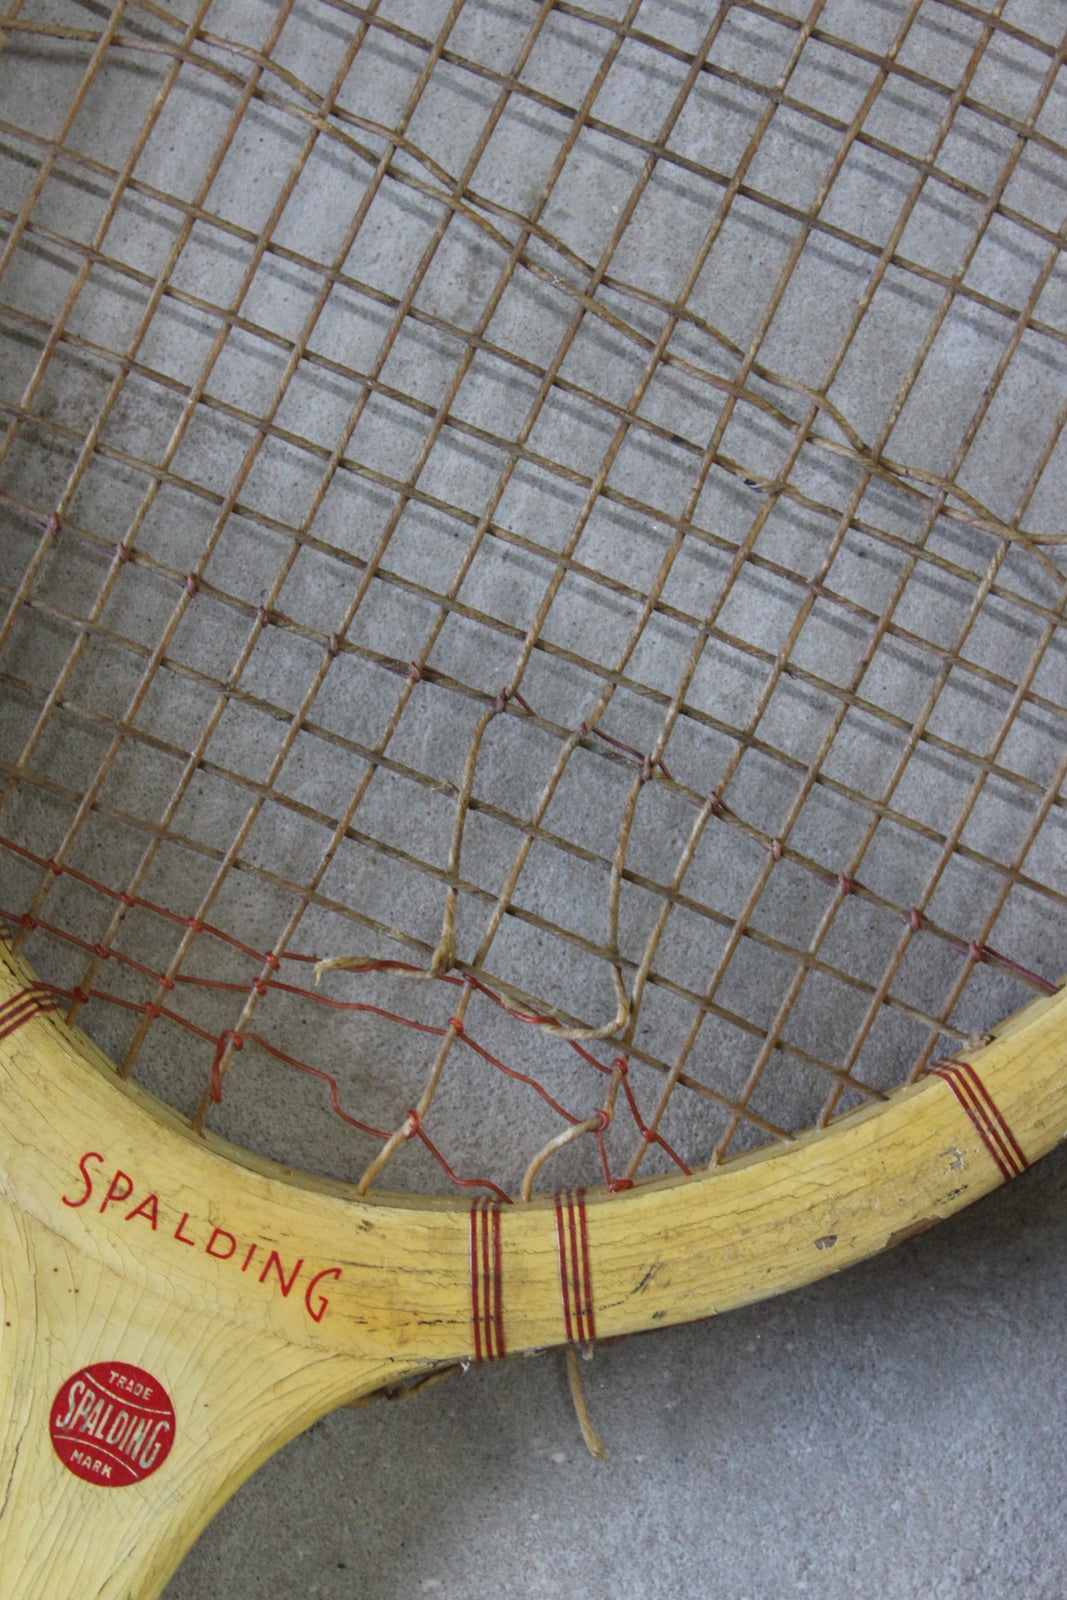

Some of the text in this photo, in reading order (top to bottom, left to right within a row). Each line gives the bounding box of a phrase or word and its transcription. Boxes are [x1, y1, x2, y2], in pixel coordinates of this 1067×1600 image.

[62, 1151, 342, 1322] SPALDING
[109, 1370, 153, 1400] TRADE
[56, 1380, 170, 1469] SPALDING
[70, 1449, 112, 1478] MARK
